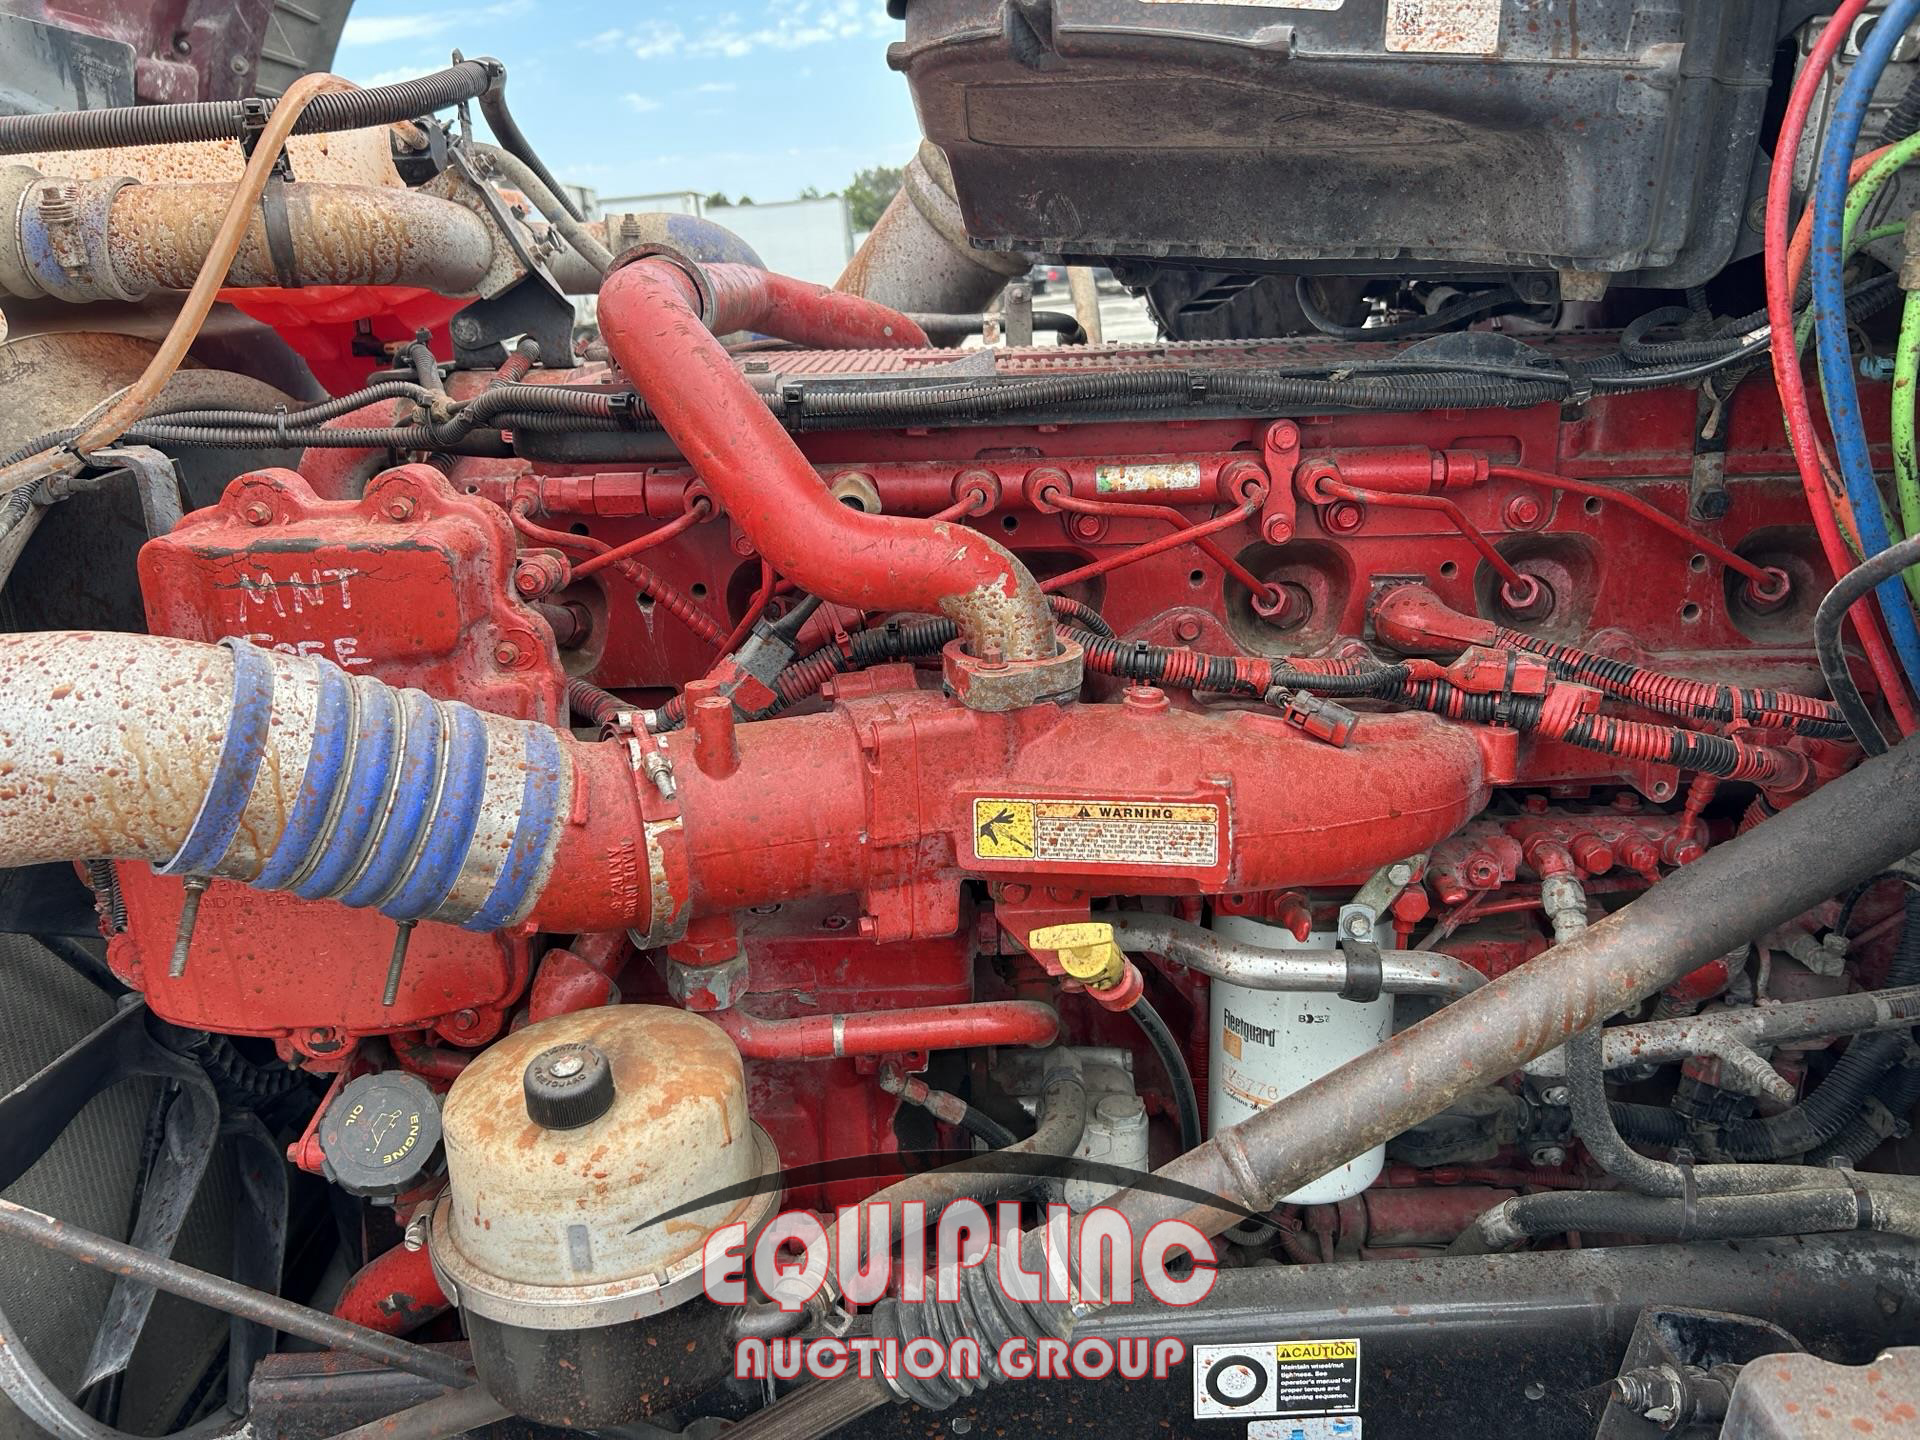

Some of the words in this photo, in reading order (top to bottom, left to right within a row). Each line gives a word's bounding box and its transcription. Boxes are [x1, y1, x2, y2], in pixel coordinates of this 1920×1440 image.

[1099, 807, 1173, 819] WARNING
[1223, 1007, 1276, 1048] Fleetguard
[345, 1104, 364, 1127] OIL
[383, 1114, 420, 1164] ENGINE
[1292, 1345, 1355, 1358] CAUTION
[1281, 1394, 1314, 1402] tightening
